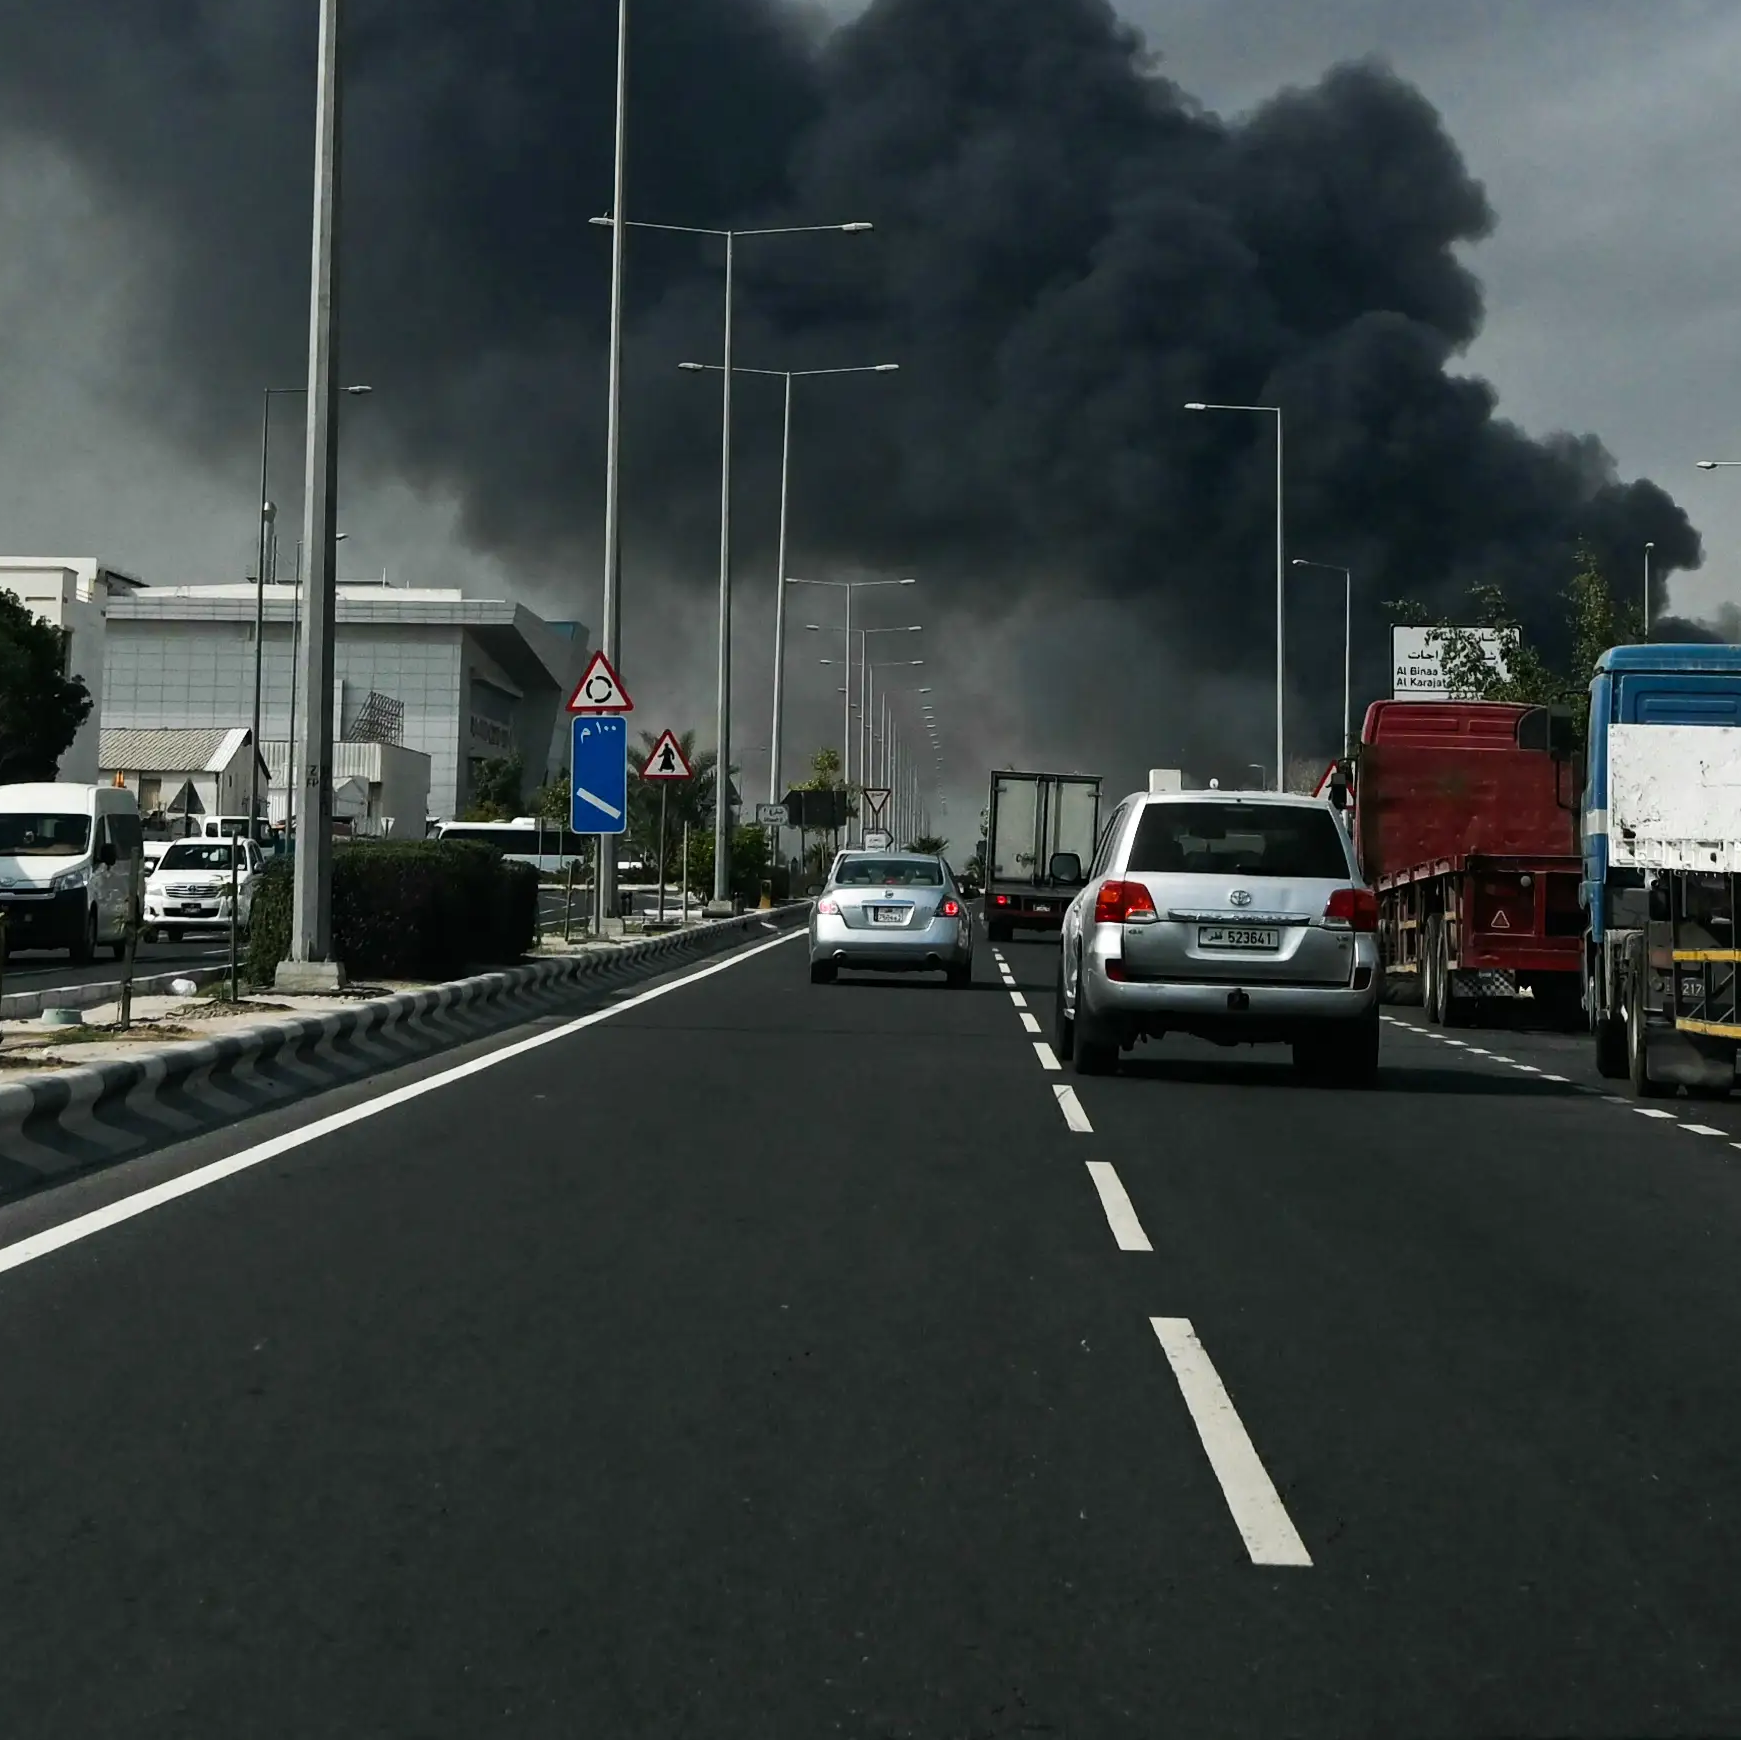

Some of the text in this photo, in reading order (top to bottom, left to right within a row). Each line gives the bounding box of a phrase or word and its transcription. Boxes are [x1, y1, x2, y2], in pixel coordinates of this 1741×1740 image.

[1396, 666, 1406, 676] Al
[1410, 666, 1438, 676] Binaa
[1396, 677, 1406, 686] Al
[580, 721, 617, 745] ١٠٠ م
[1227, 931, 1271, 945] 523641
